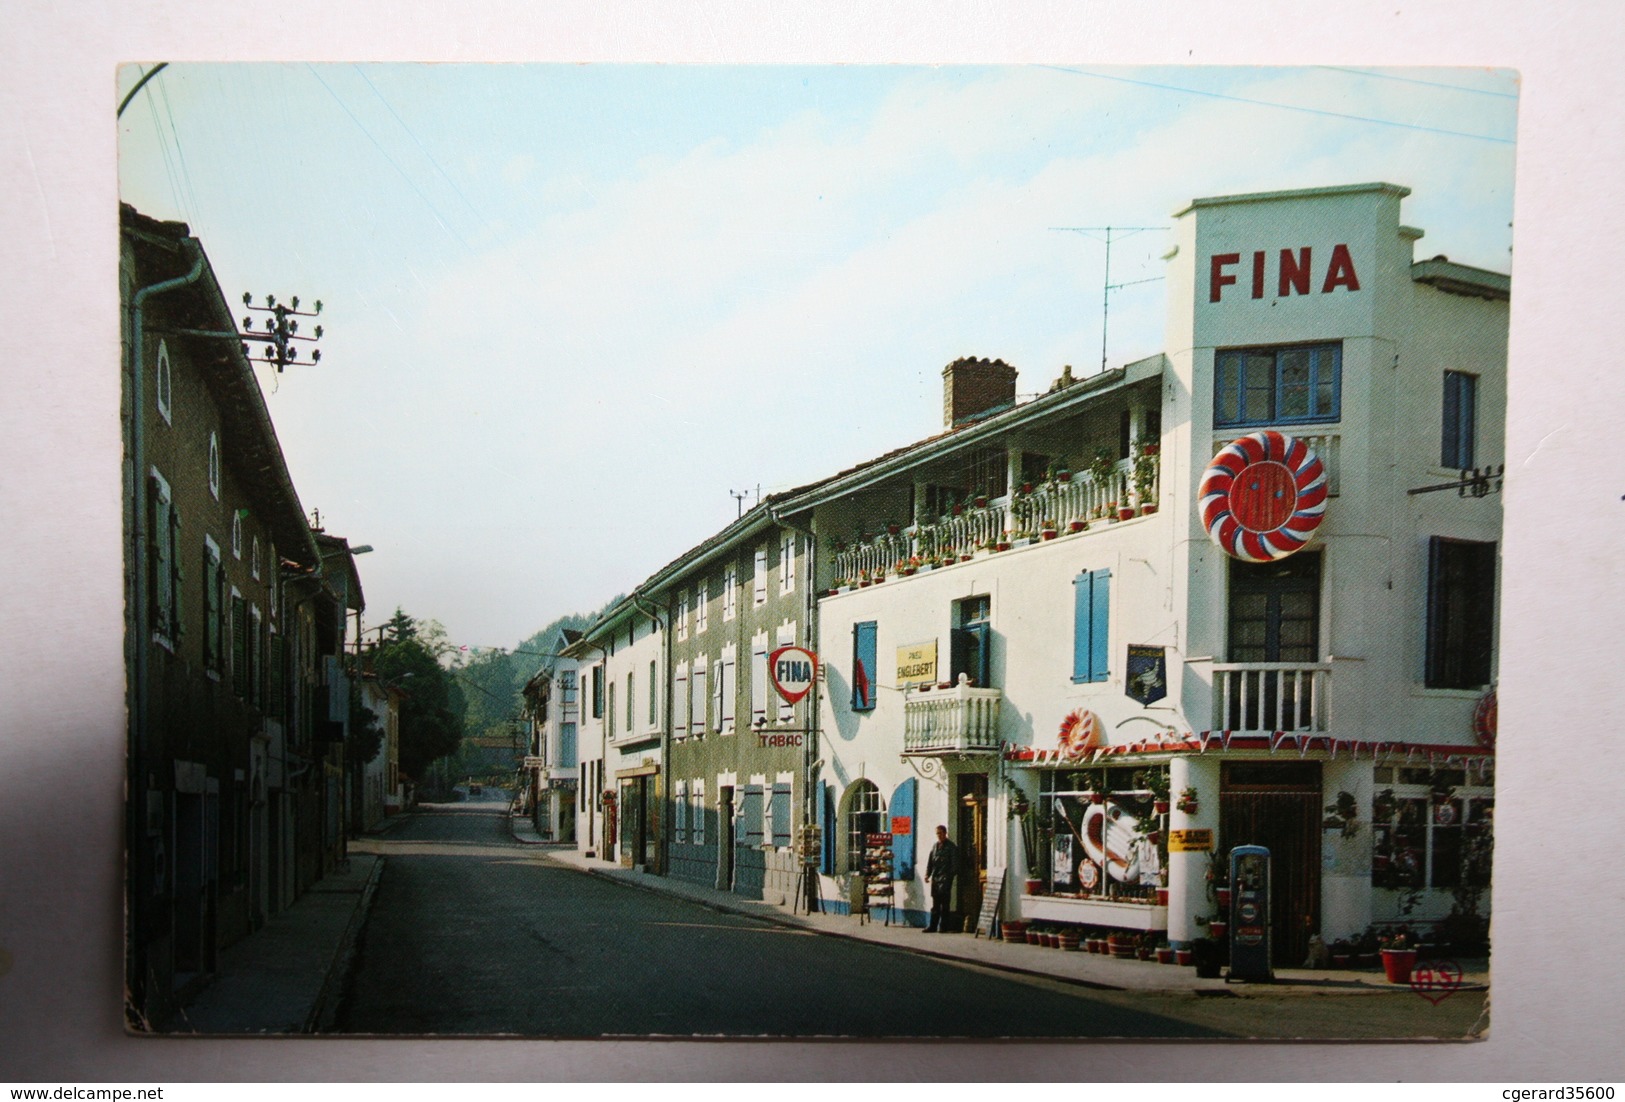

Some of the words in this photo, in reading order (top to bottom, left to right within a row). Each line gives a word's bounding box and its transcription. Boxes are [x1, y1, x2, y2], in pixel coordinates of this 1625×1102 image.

[1209, 243, 1361, 303] FINA
[776, 660, 812, 683] FINA
[897, 662, 934, 679] ENGLEBERT
[759, 734, 803, 748] TABAC
